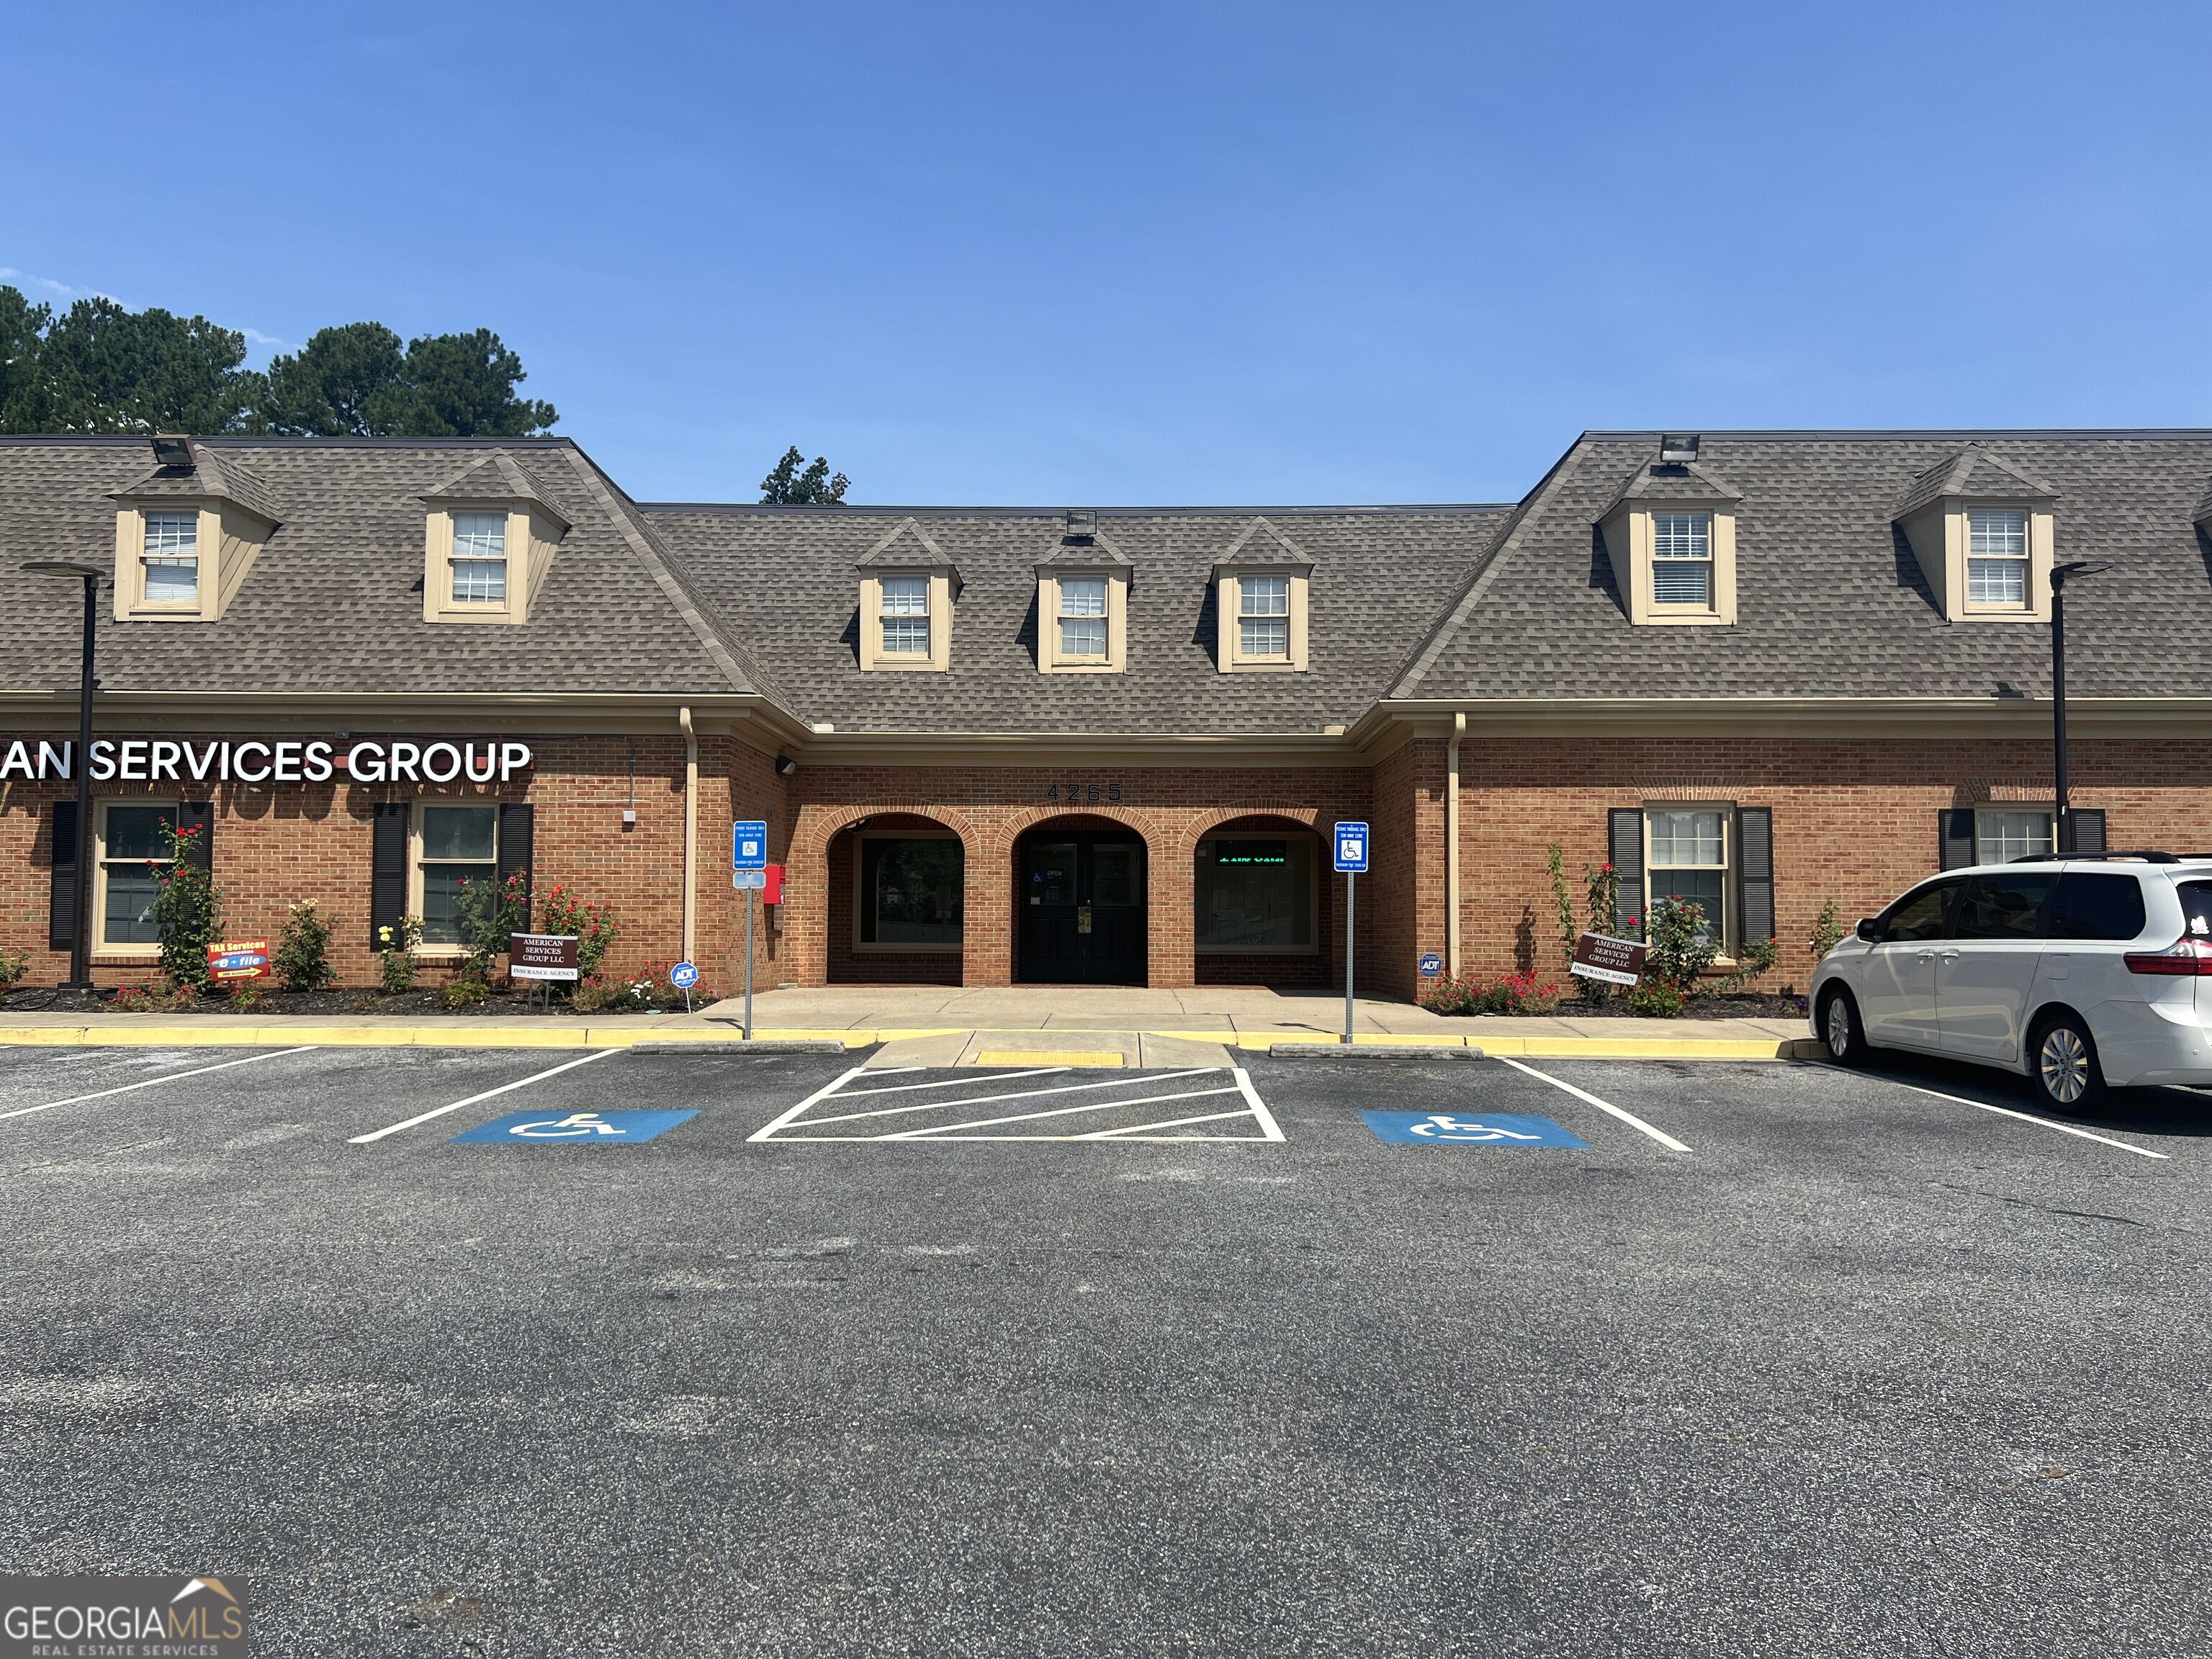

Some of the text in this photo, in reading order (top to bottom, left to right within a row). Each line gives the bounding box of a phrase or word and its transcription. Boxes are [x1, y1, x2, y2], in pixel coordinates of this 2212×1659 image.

[0, 740, 531, 783] AN SERVICES GROUP
[1048, 783, 1123, 801] 4265
[227, 941, 266, 951] Services
[523, 938, 564, 947] AMERICAN
[1594, 939, 1635, 953] AMERICAN
[525, 946, 562, 955] SERVICES
[1593, 947, 1630, 960] SERVICES
[523, 954, 549, 963] GROUP
[1588, 953, 1615, 966] GROUP
[1421, 961, 1439, 970] ADT
[675, 968, 694, 981] ADT
[1574, 965, 1635, 981] INSURANCE AGENCY
